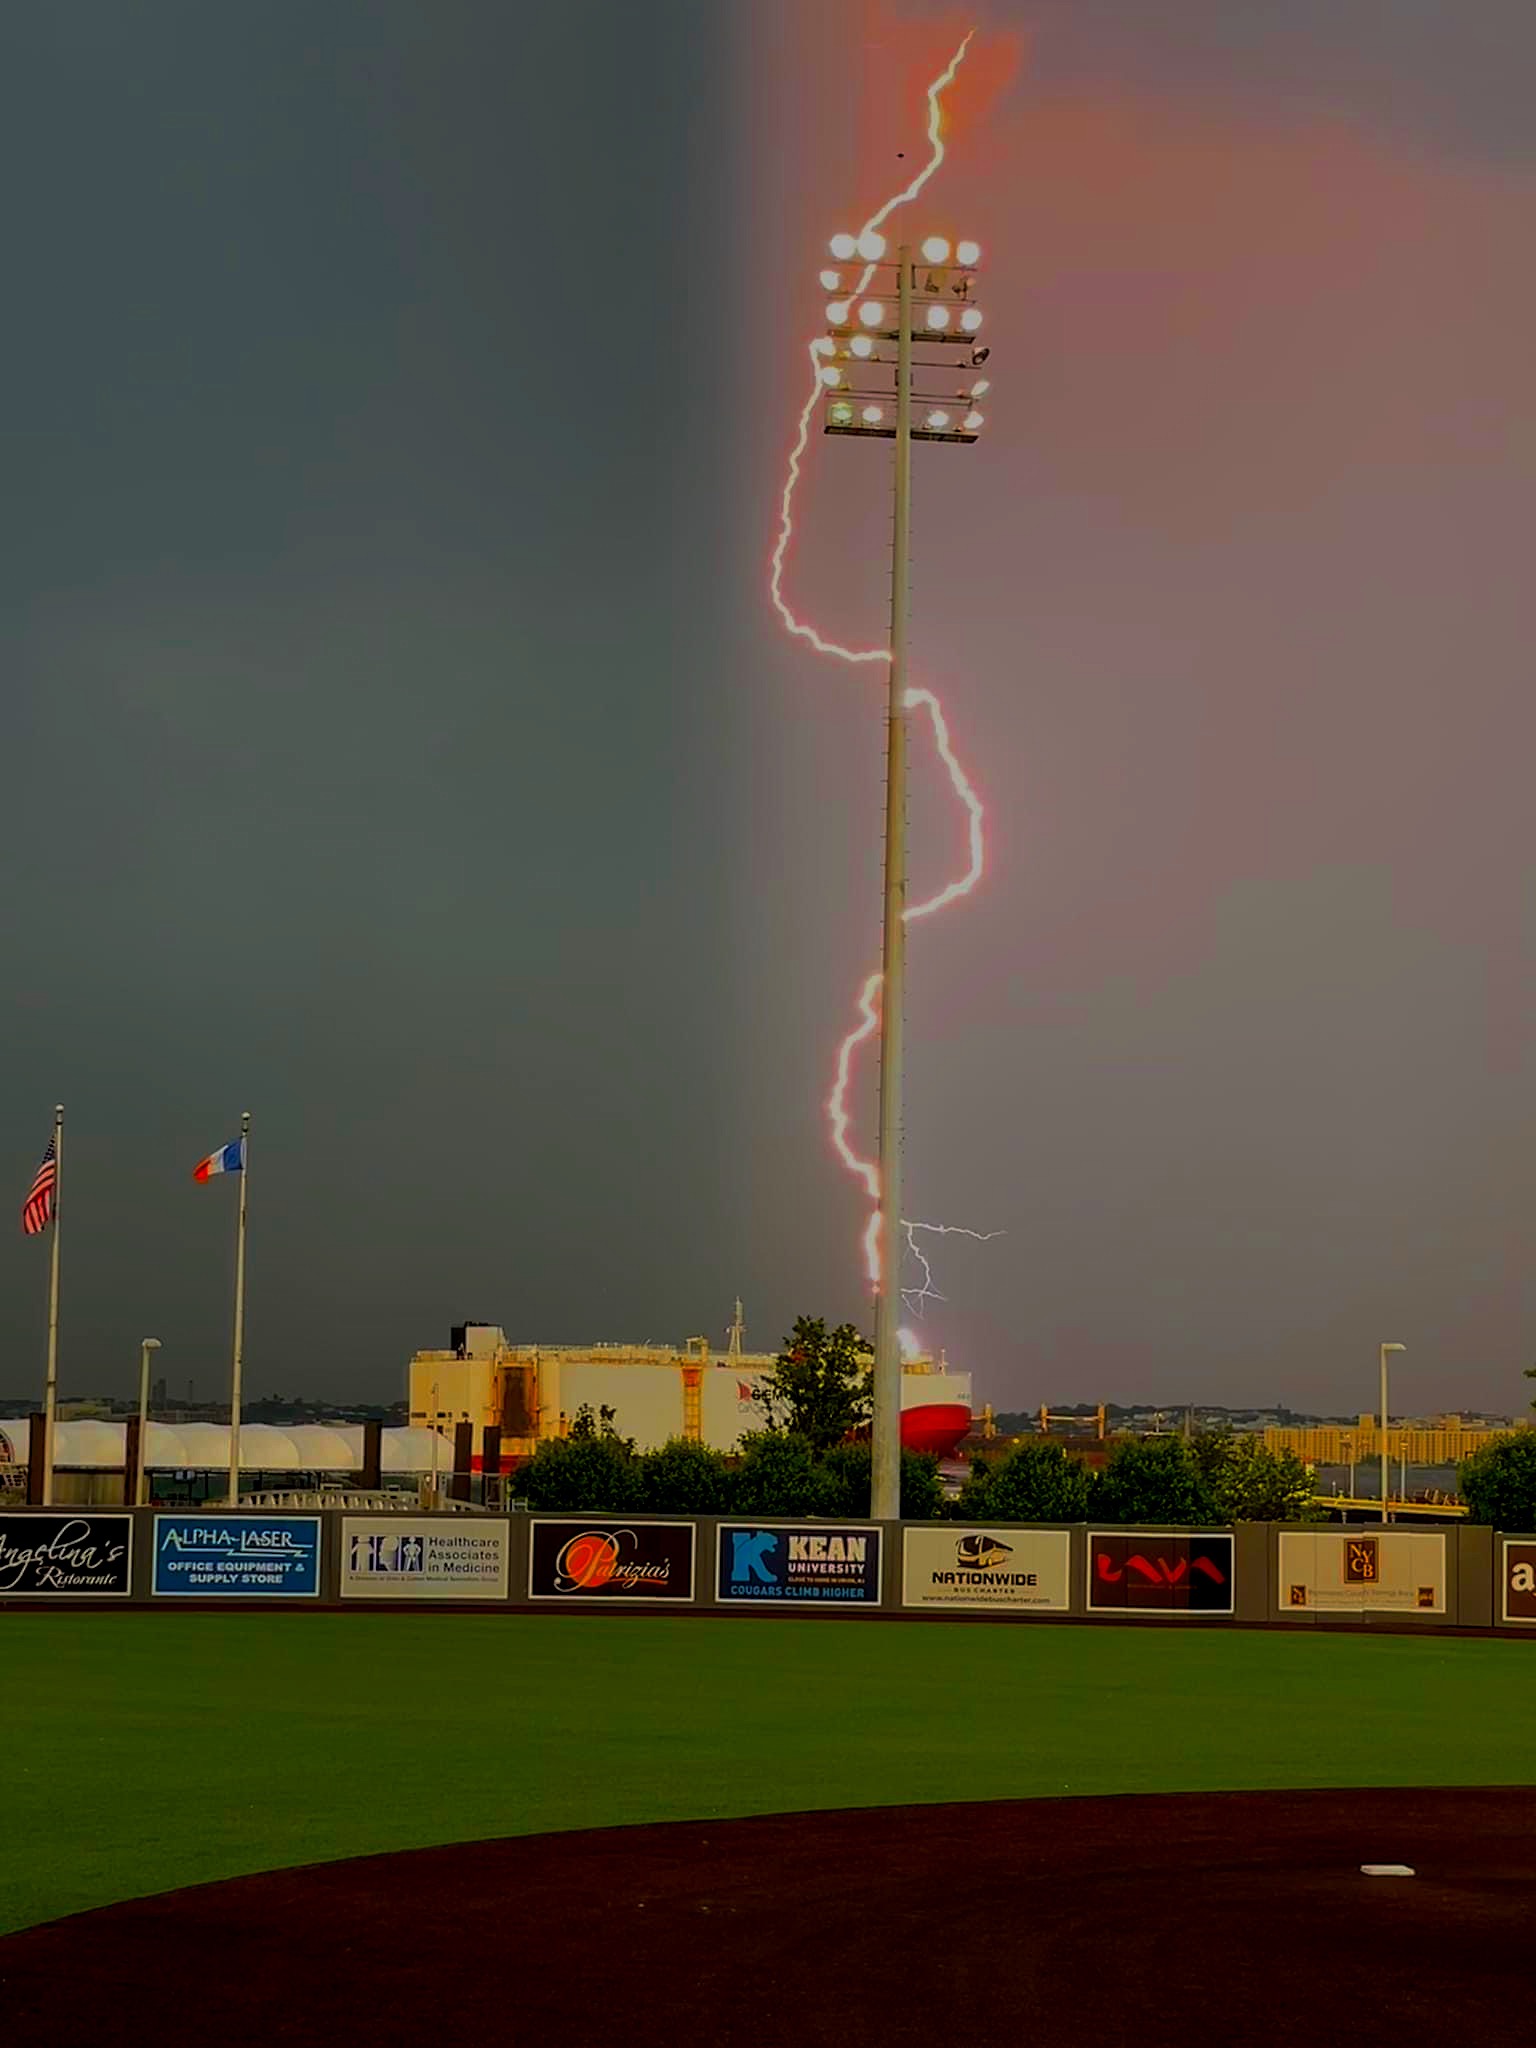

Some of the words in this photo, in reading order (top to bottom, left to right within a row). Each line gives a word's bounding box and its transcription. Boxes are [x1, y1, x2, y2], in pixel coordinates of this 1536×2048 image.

[429, 1537, 500, 1547] Healthcare
[788, 1536, 867, 1561] KEAN
[429, 1550, 500, 1560] Associates
[168, 1562, 214, 1571] OFFICE
[217, 1562, 291, 1572] EQUIPMENT
[295, 1563, 305, 1572] &
[428, 1563, 440, 1572] in
[444, 1563, 500, 1573] Medicine
[788, 1563, 865, 1574] UNIVERSITY
[35, 1566, 118, 1588] Ristorante
[189, 1574, 237, 1583] SUPPLY
[242, 1574, 283, 1584] STORE
[932, 1572, 1038, 1586] NATIONWIDE
[731, 1585, 783, 1596] COUGARS
[785, 1586, 820, 1597] CLIMB
[822, 1587, 865, 1598] HIGHER
